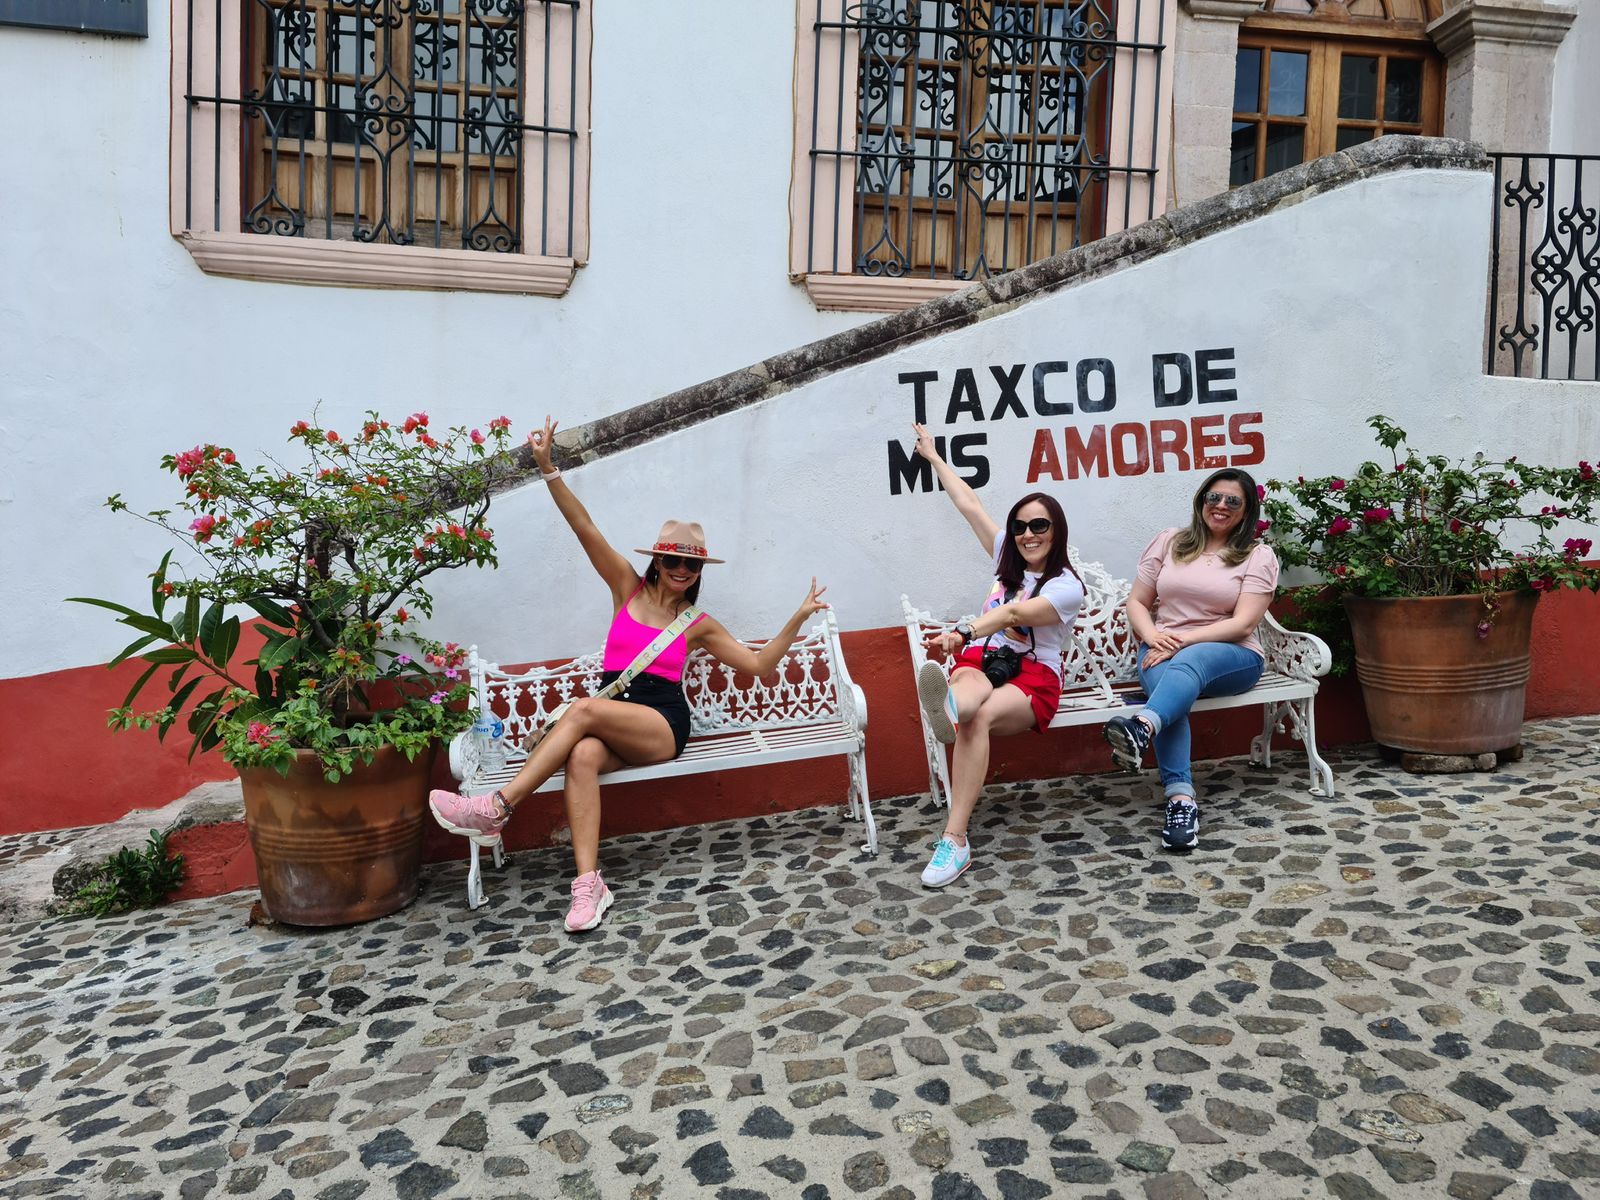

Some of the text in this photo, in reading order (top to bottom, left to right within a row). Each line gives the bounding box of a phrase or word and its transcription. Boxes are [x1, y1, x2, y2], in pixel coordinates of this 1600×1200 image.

[898, 348, 1238, 425] TAXCO DE
[1026, 412, 1266, 483] AMORES
